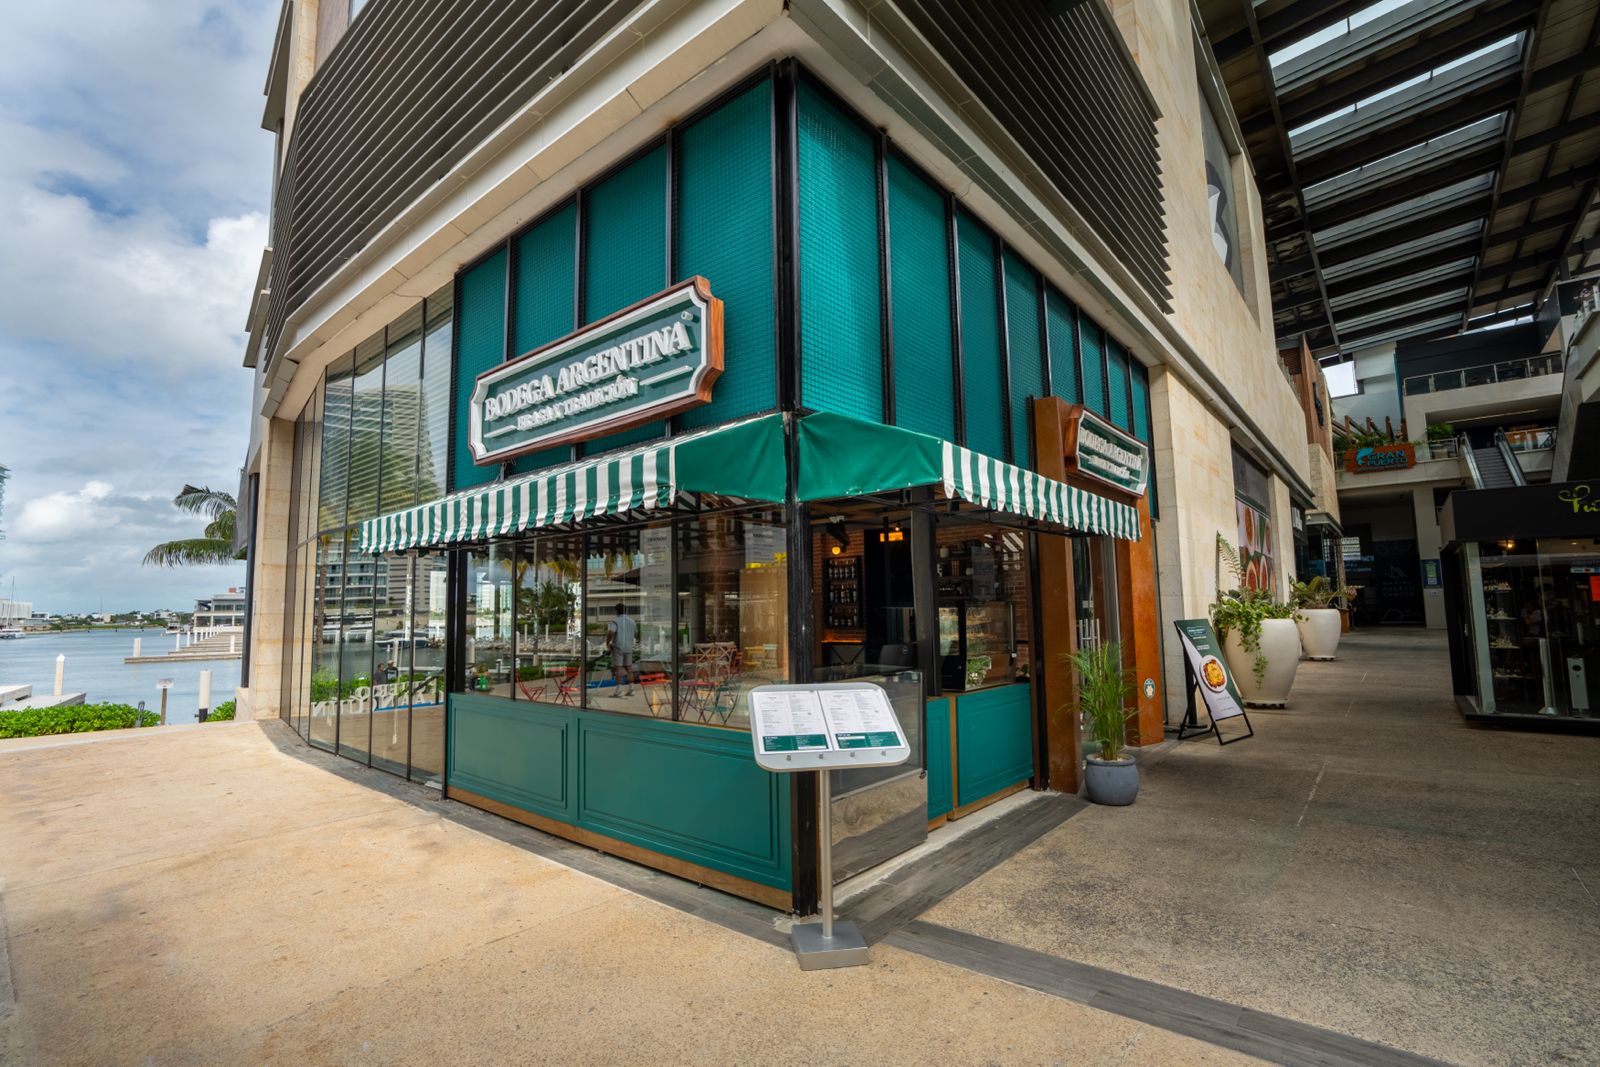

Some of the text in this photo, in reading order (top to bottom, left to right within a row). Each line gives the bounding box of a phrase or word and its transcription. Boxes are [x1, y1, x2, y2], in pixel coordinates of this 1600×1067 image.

[484, 321, 693, 421] BODEGA ARGENTINA
[1368, 450, 1405, 460] GRAN
[1368, 457, 1408, 466] PUERTO
